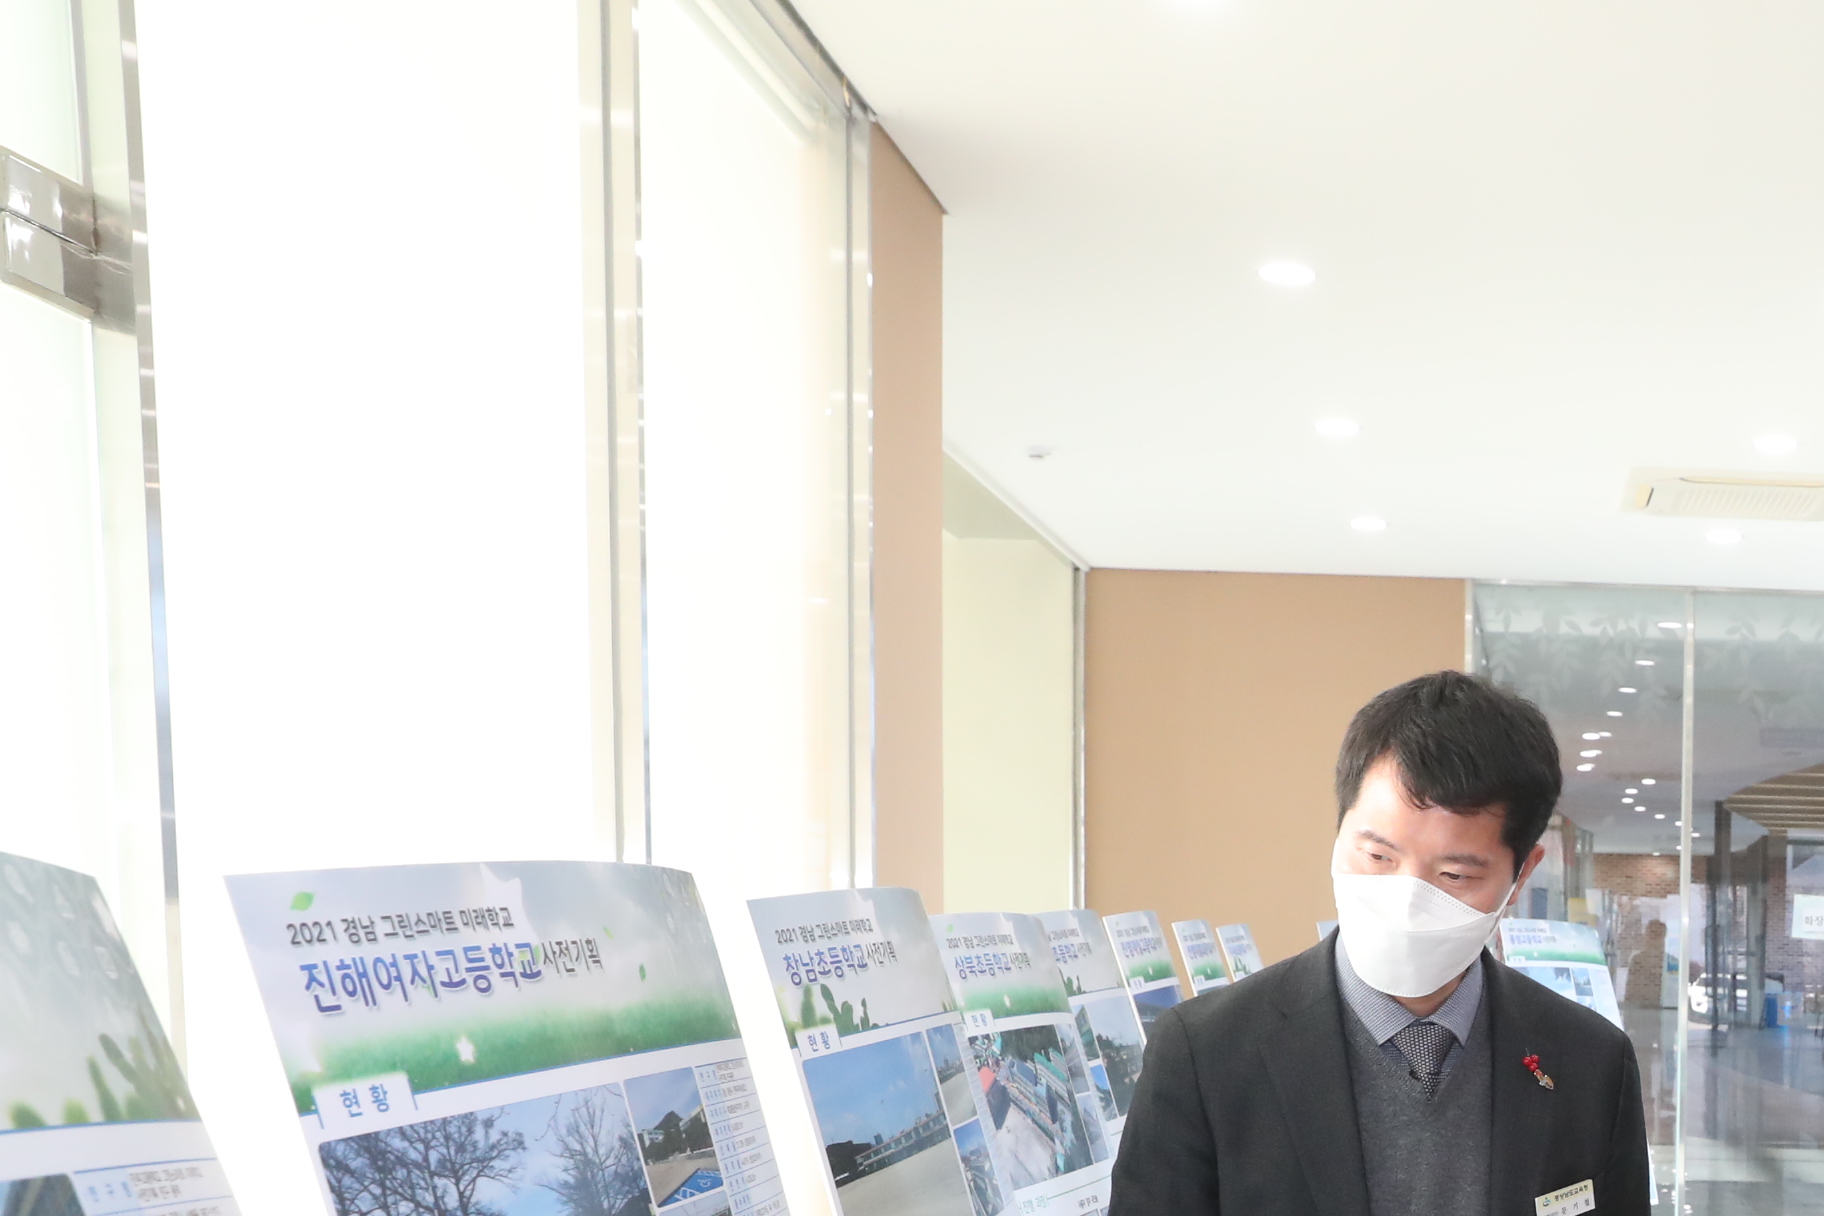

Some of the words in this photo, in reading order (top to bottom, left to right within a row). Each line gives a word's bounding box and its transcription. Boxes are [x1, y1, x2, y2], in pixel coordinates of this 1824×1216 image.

[286, 920, 338, 945] 2021
[340, 915, 378, 944] 경남
[380, 910, 459, 938] 그린스마트
[459, 906, 514, 932] 미래학교
[775, 928, 799, 944] 2021
[799, 924, 817, 943] 경남
[816, 921, 850, 940] 그린스마트
[849, 918, 874, 936] 미래학교
[299, 942, 542, 1013] 진해여자고등학교
[541, 937, 603, 974] 사전기획
[782, 944, 868, 986] 창남초등학교
[866, 940, 898, 966] 사전기획
[954, 952, 1012, 980] 상북초등학교
